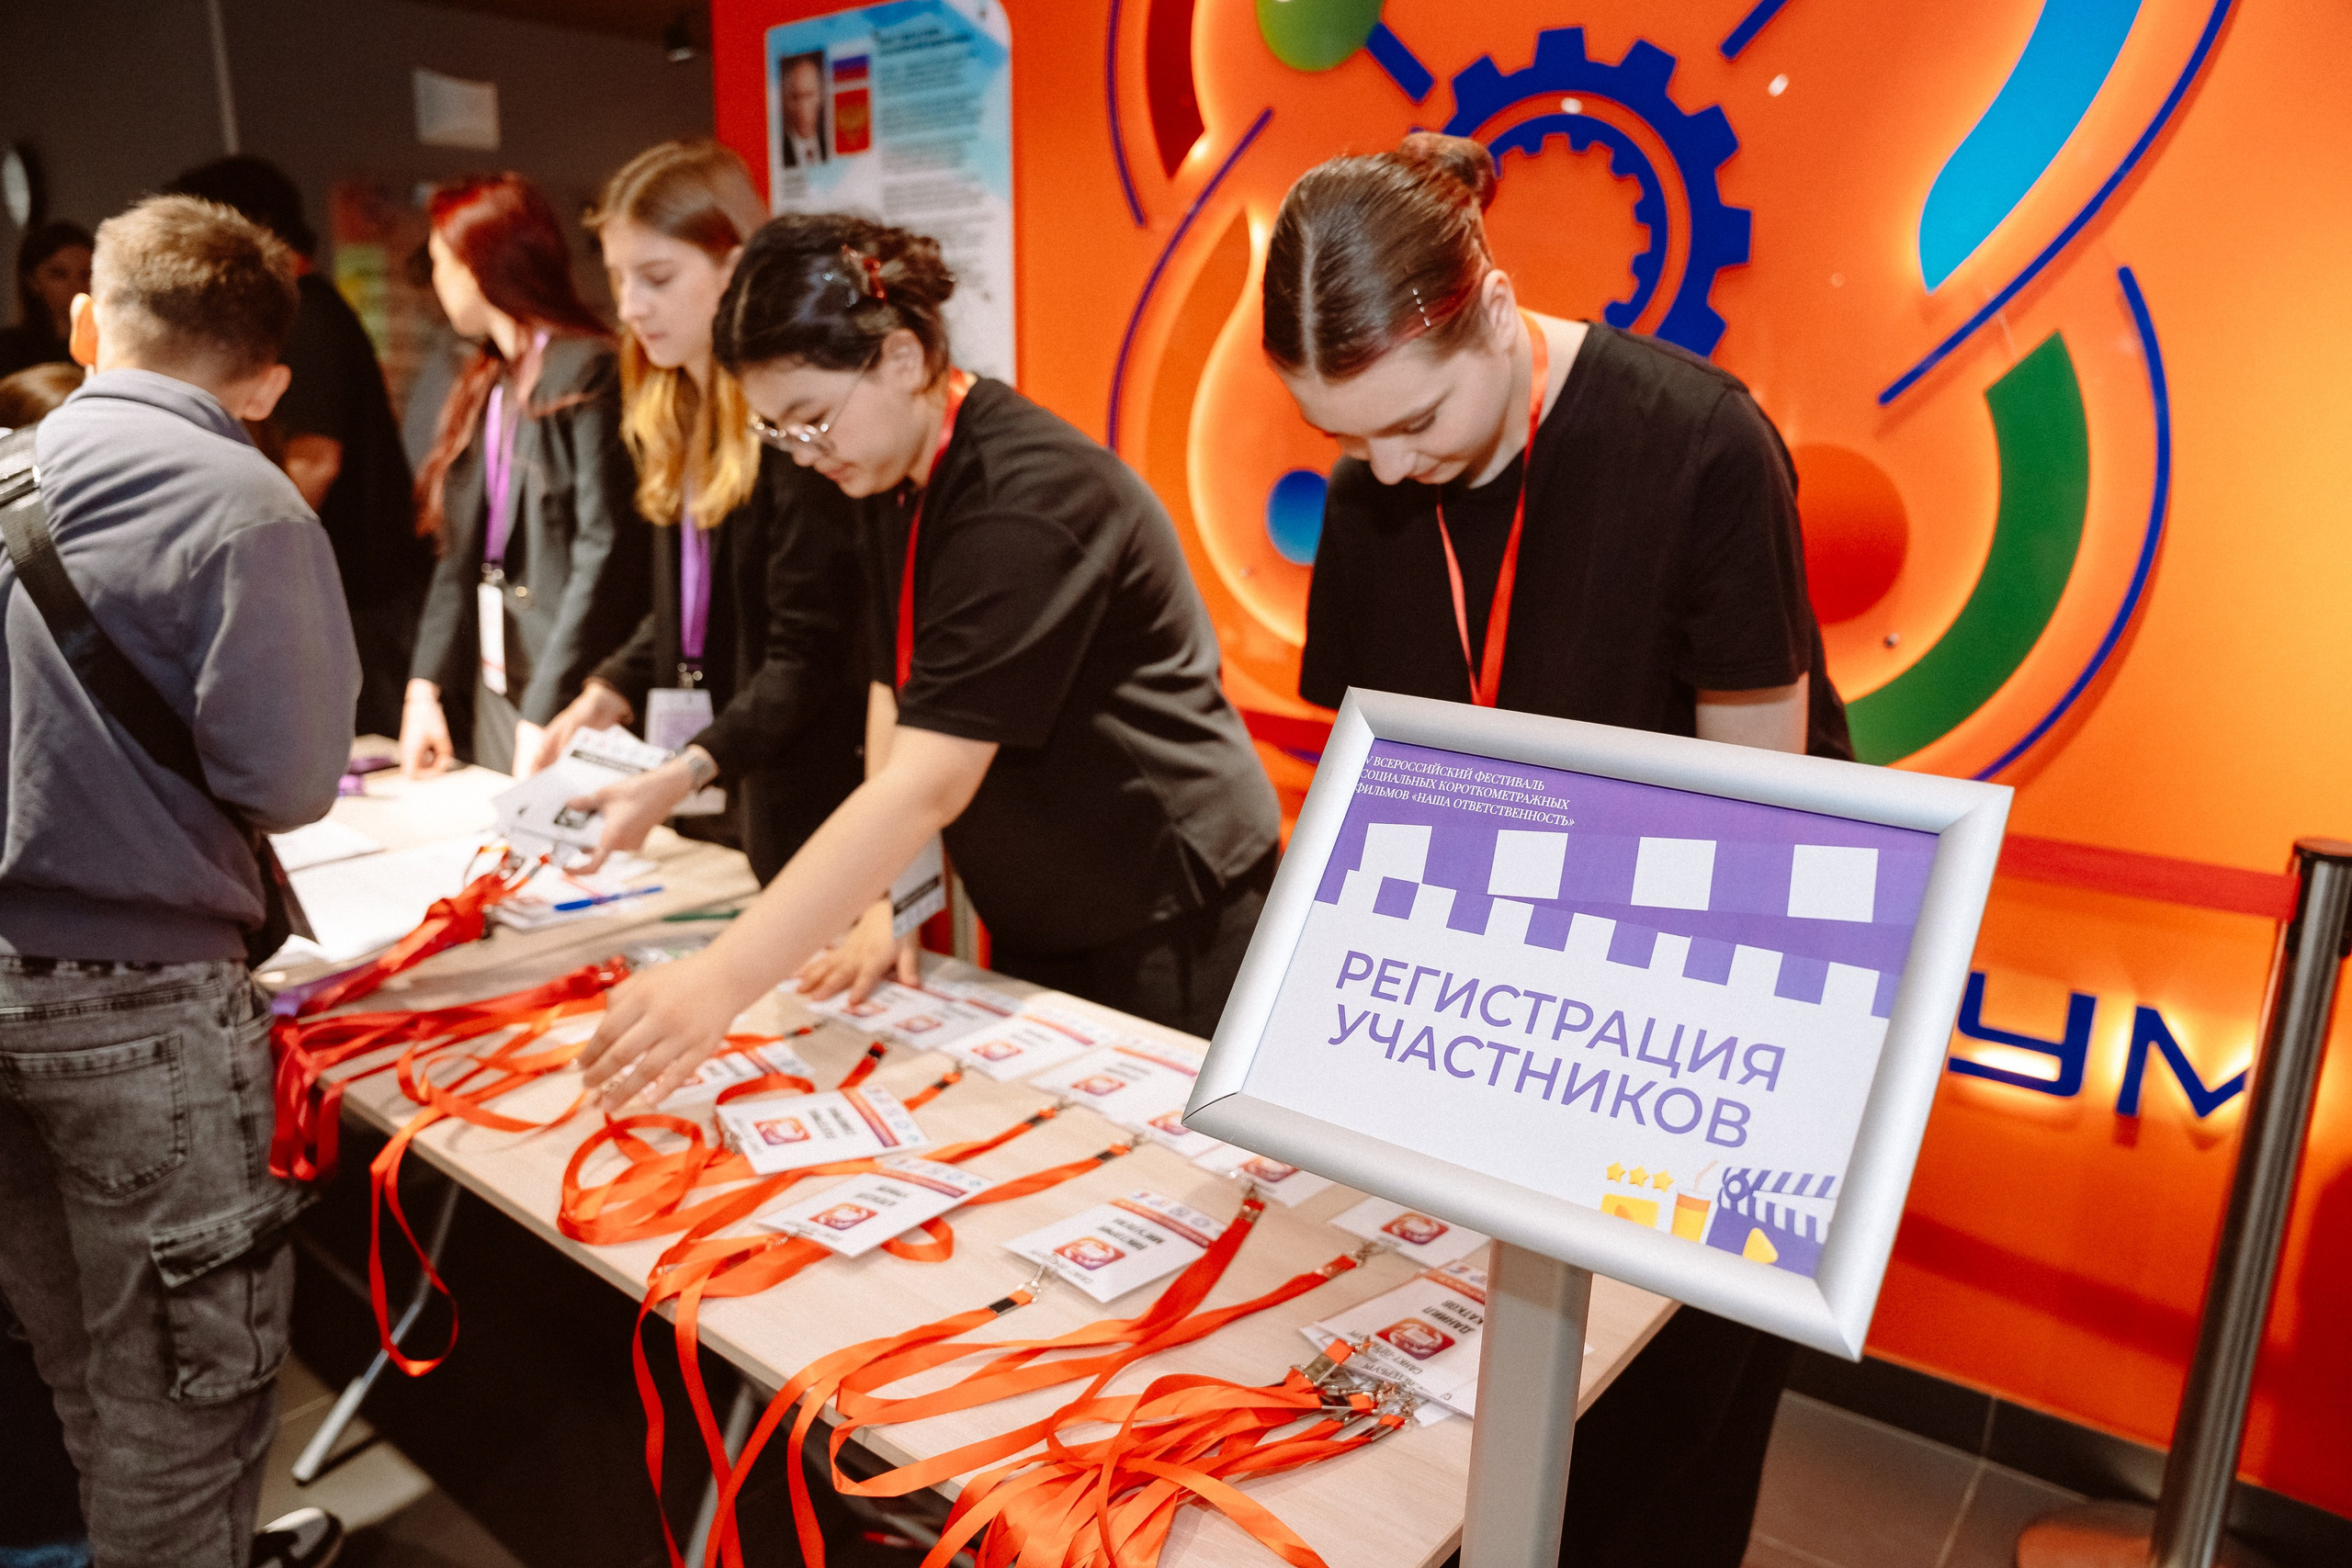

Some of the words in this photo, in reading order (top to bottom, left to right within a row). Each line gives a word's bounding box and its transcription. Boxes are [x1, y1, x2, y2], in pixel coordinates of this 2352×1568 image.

[1360, 768, 1438, 790] СОЦИАЛЬНЫХ
[1438, 780, 1570, 810] КОРОТКОМЕТРАЖНЫХ
[1374, 757, 1474, 781] ВСЕРОССИЙСКИЙ
[1475, 771, 1545, 791] ФЕСТИВАЛЬ
[1355, 782, 1410, 801] ФИЛЬМОВ
[1411, 792, 1451, 807] «НАША
[1453, 798, 1575, 827] ОТВЕТСТВЕННОСТЬ»
[1335, 949, 1786, 1093] РЕГИСТРАЦИЯ
[1328, 1003, 1753, 1148] УЧАСТНИКОВ
[1422, 1305, 1476, 1335] ДАНИИЛ
